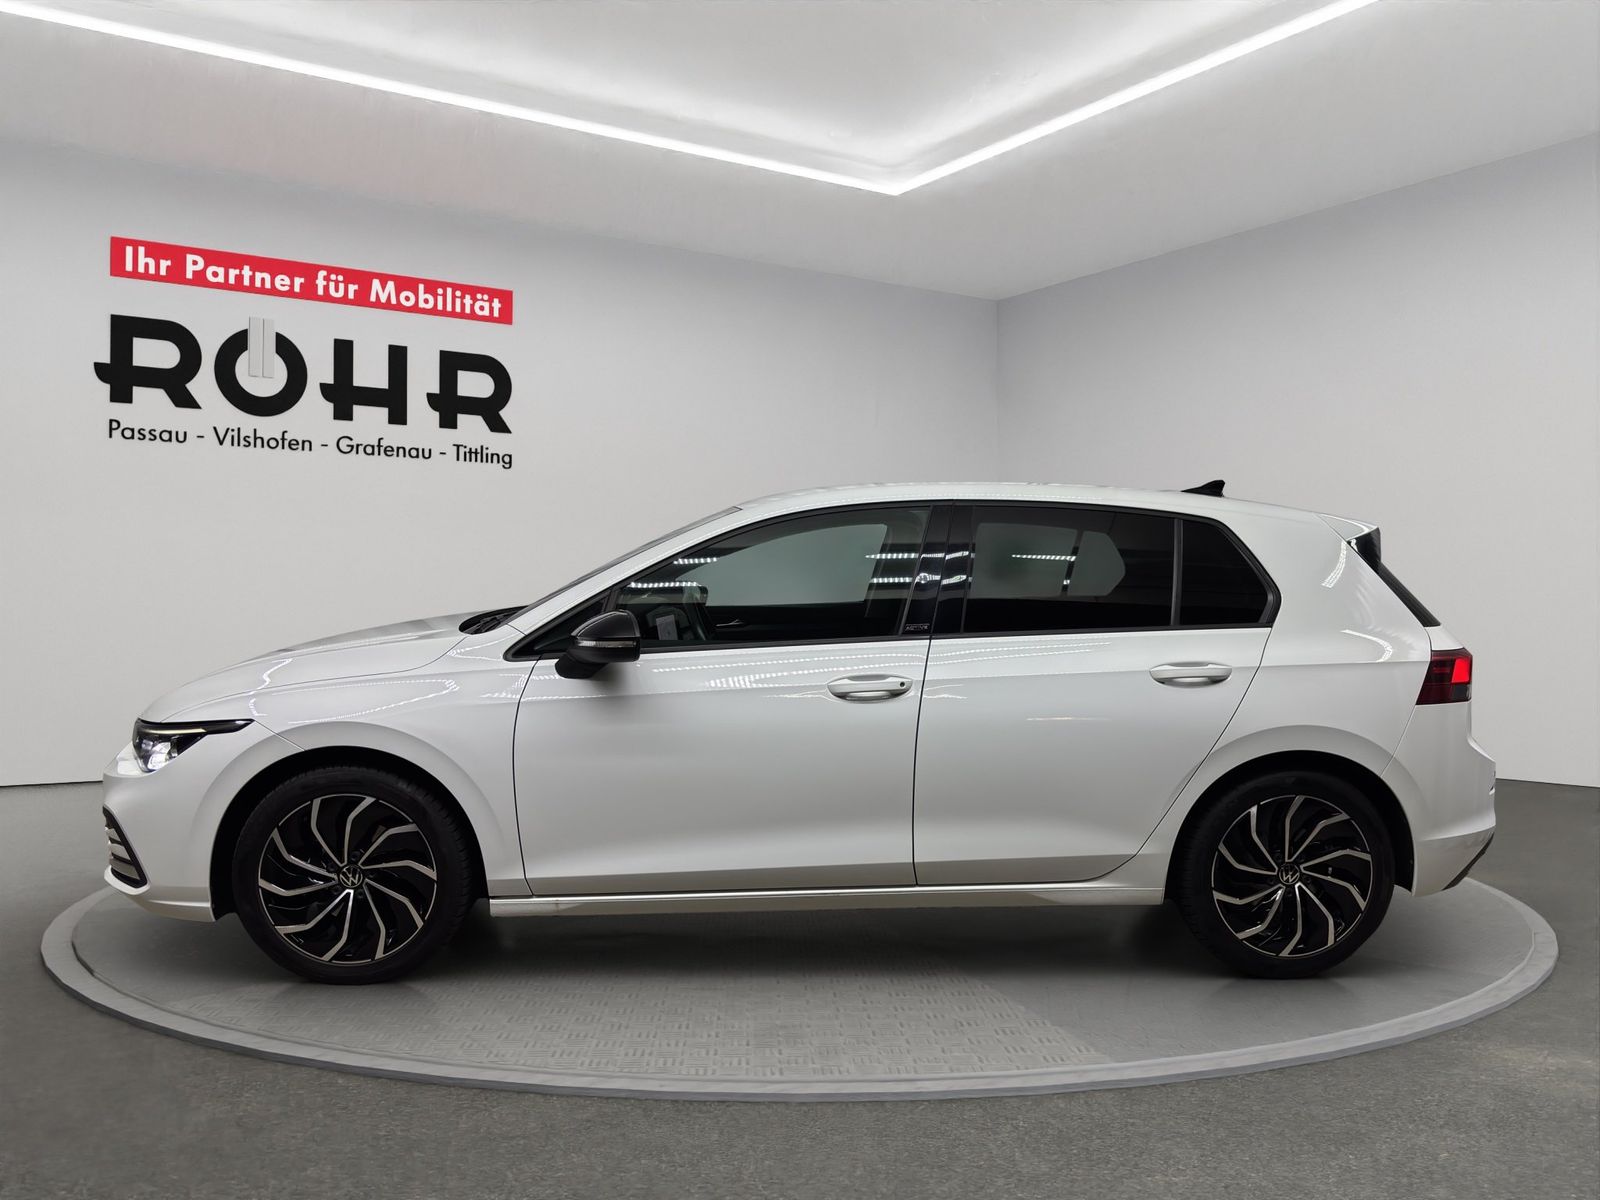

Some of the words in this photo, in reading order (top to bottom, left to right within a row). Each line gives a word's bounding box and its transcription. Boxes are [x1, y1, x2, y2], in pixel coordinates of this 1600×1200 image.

[125, 245, 172, 276] Ihr
[185, 253, 305, 293] Partner
[315, 269, 359, 300] für
[369, 278, 502, 318] Mobilität
[108, 418, 188, 444] Passau
[212, 426, 313, 452] Vilshofen
[336, 435, 432, 460] Grafenau
[452, 443, 513, 470] Tittling
